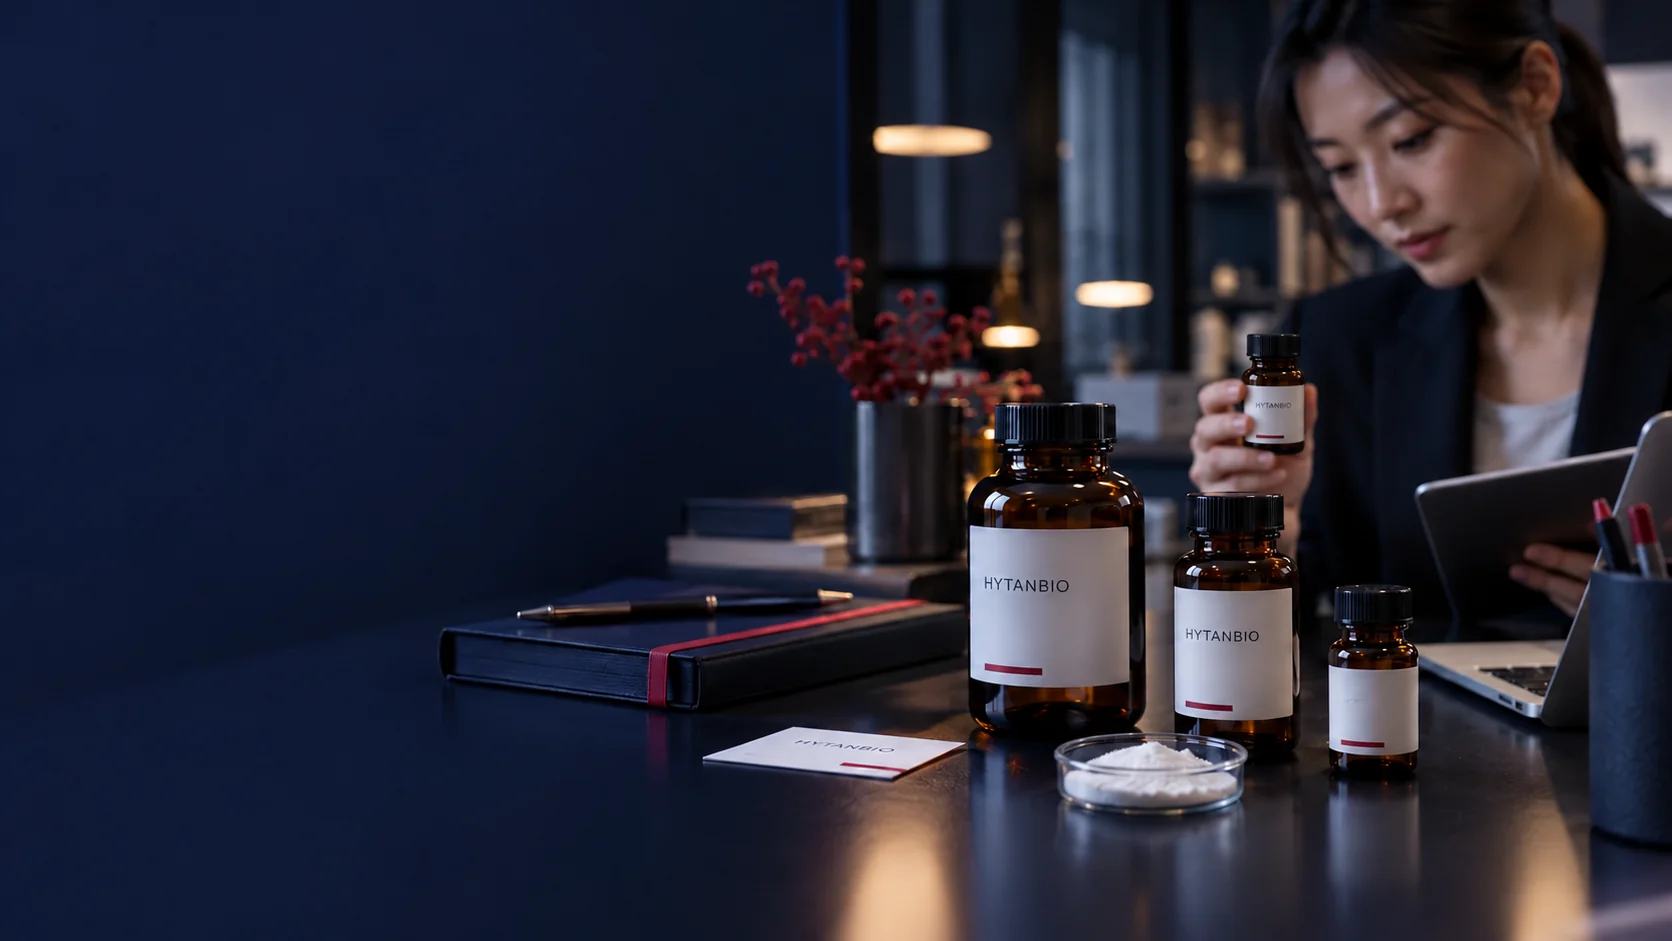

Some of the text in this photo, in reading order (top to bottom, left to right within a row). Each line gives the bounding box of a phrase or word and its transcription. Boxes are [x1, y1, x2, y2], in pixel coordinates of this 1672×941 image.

[984, 577, 1070, 593] HYTANBIO
[1185, 628, 1260, 643] HYTANBIO
[794, 739, 894, 753] HYTANBIO
